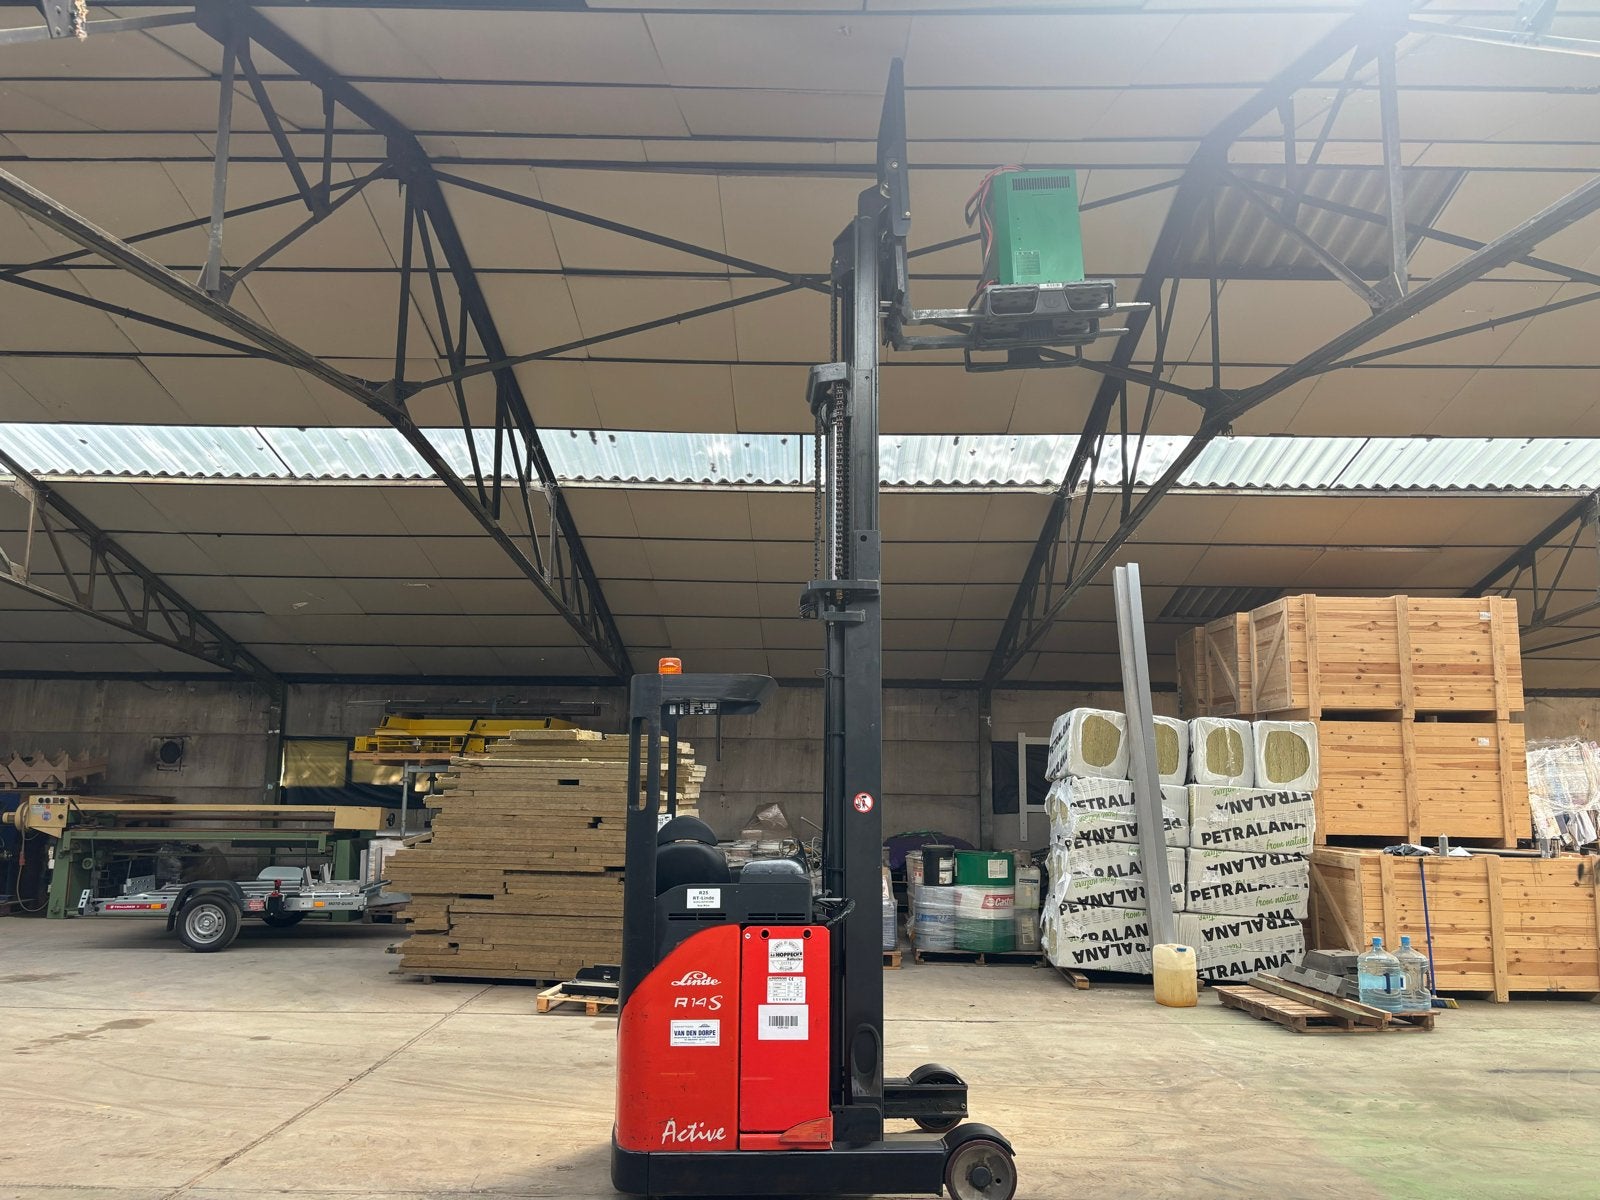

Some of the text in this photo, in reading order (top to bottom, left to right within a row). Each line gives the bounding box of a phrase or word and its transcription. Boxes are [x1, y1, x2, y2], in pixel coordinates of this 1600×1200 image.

[1266, 836, 1308, 850] from nature
[1256, 893, 1299, 907] from nature
[671, 970, 722, 986] Linde
[674, 1029, 685, 1037] VAN
[662, 1117, 727, 1144] Active
